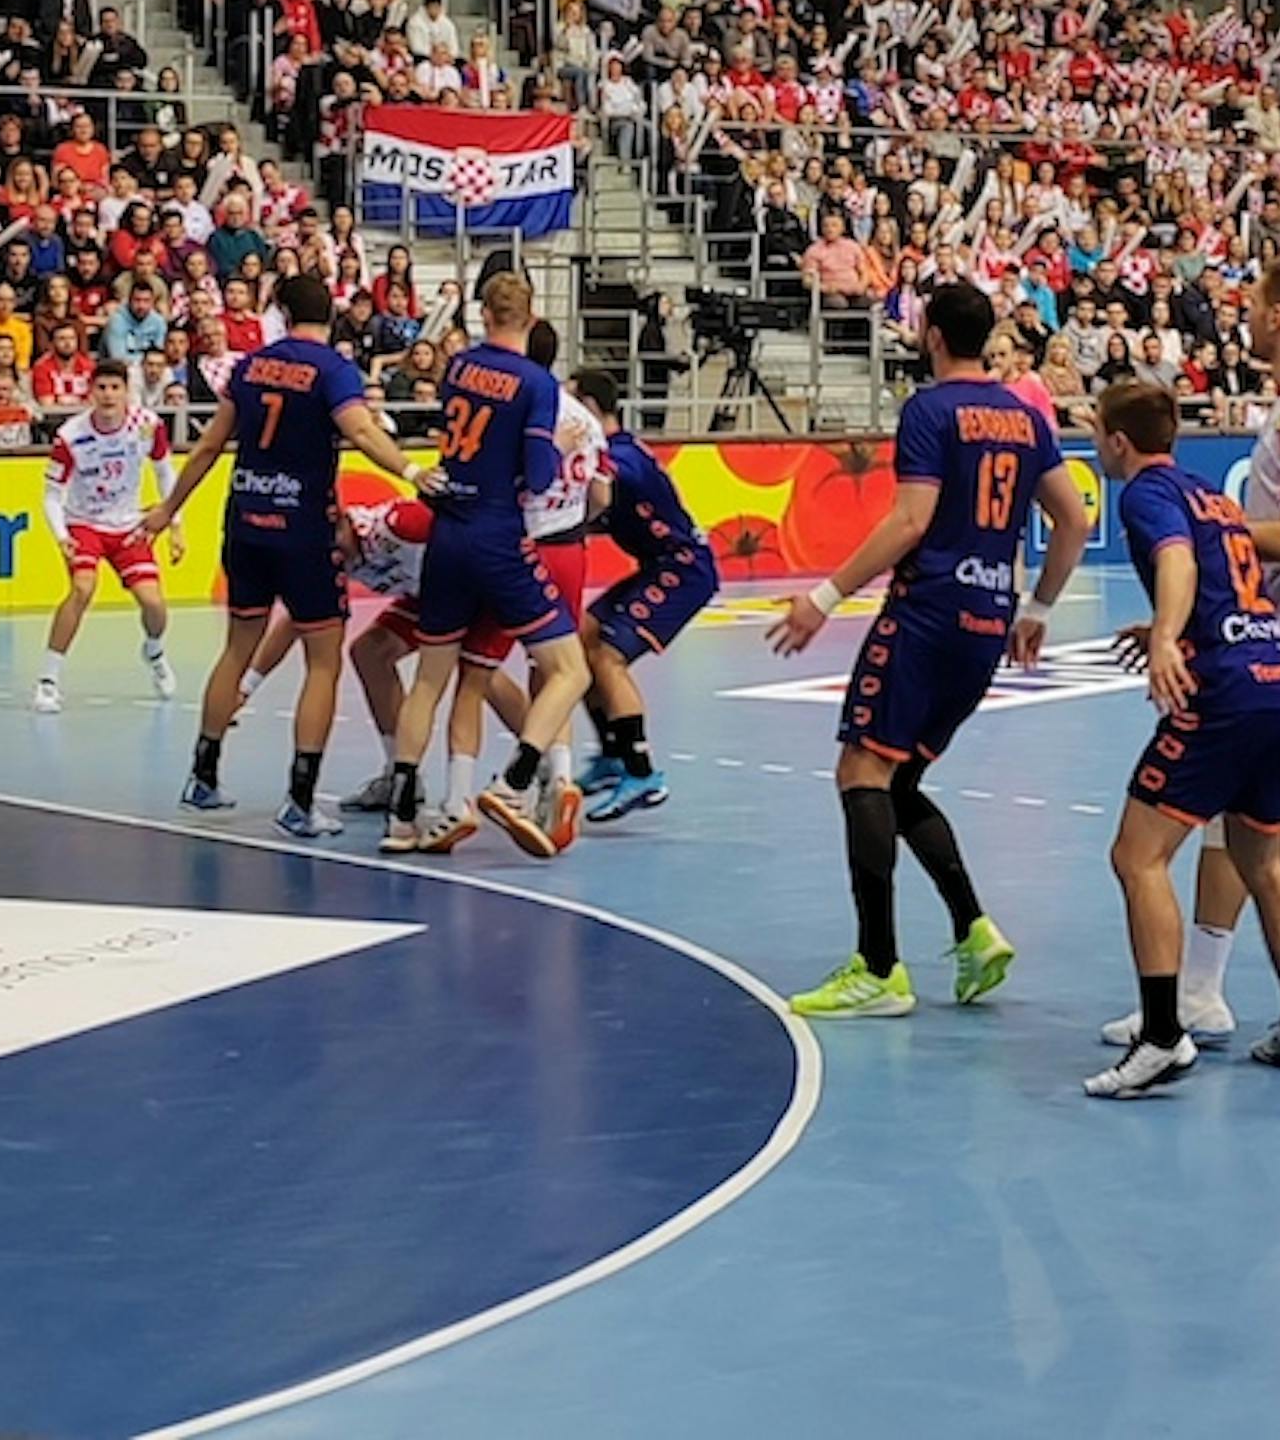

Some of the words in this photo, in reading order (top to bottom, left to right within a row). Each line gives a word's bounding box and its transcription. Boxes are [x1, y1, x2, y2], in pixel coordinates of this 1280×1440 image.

[258, 392, 284, 449] 7
[438, 395, 494, 463] 34
[975, 450, 1019, 531] 13
